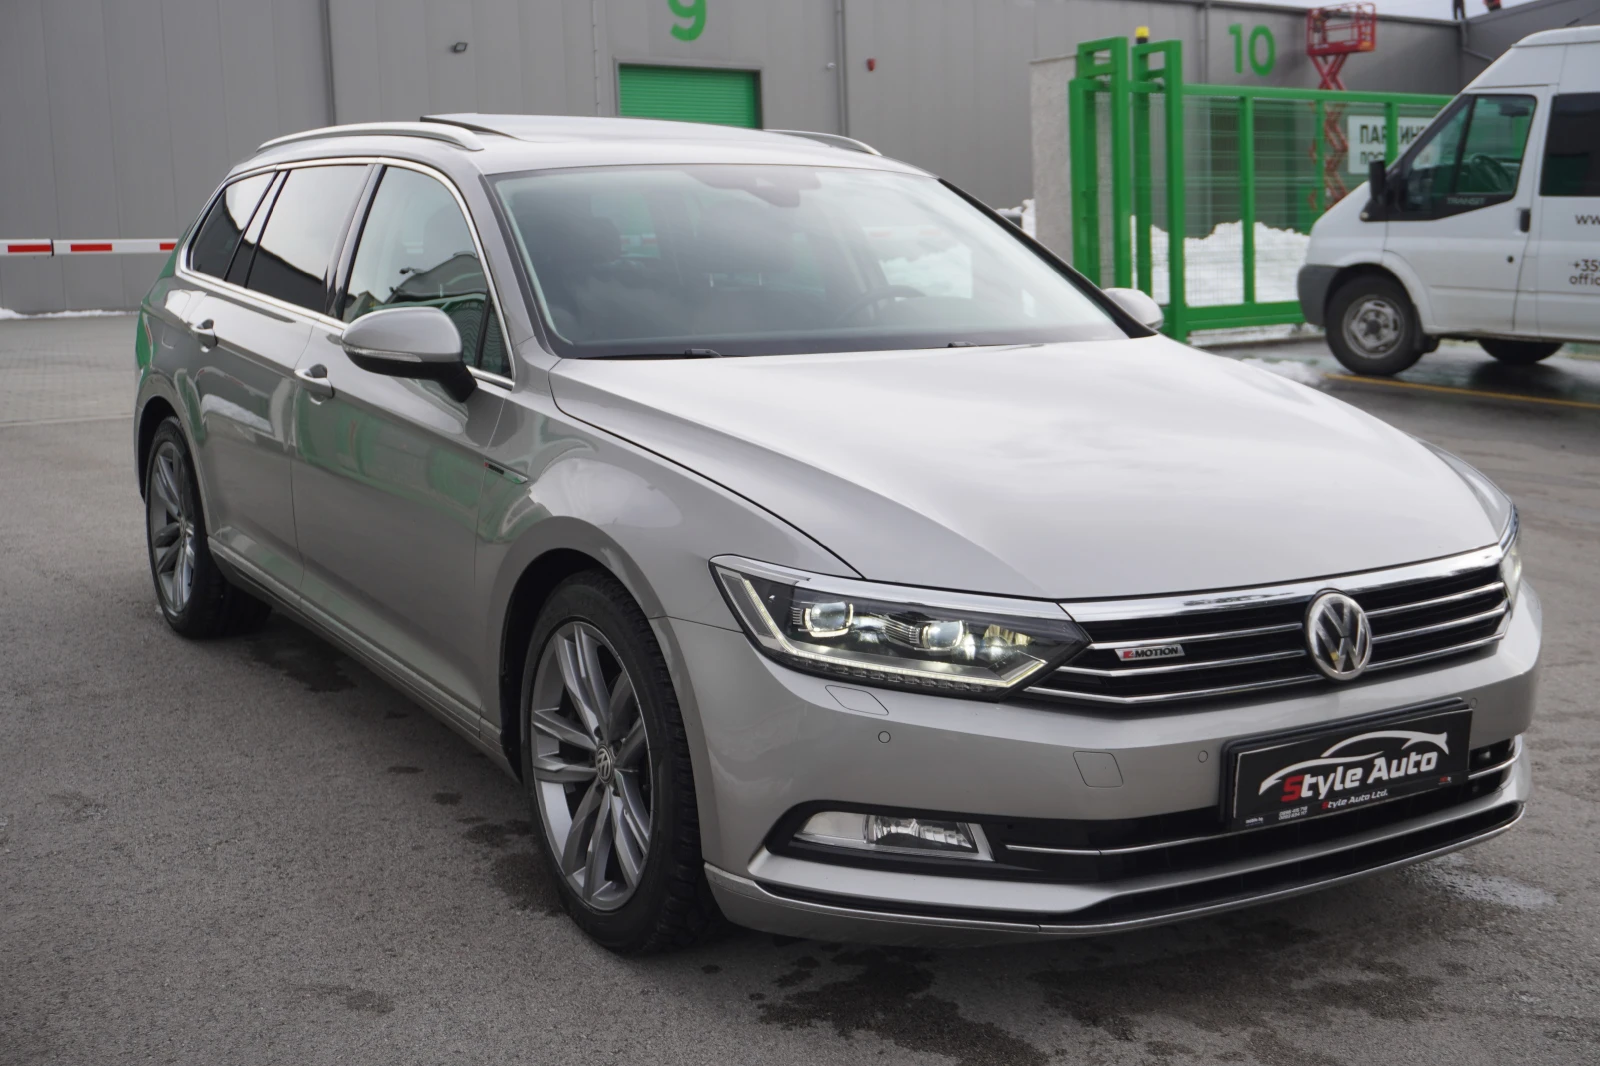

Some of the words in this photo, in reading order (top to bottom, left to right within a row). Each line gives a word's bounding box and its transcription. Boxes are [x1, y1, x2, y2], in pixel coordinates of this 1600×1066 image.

[667, 0, 707, 42] 9
[1229, 24, 1275, 76] 10
[1573, 258, 1600, 272] +35
[1281, 766, 1363, 803] Style
[1367, 751, 1438, 784] Auto
[1321, 798, 1347, 809] Style
[1349, 793, 1370, 804] Auto
[1372, 789, 1388, 799] Ltd.
